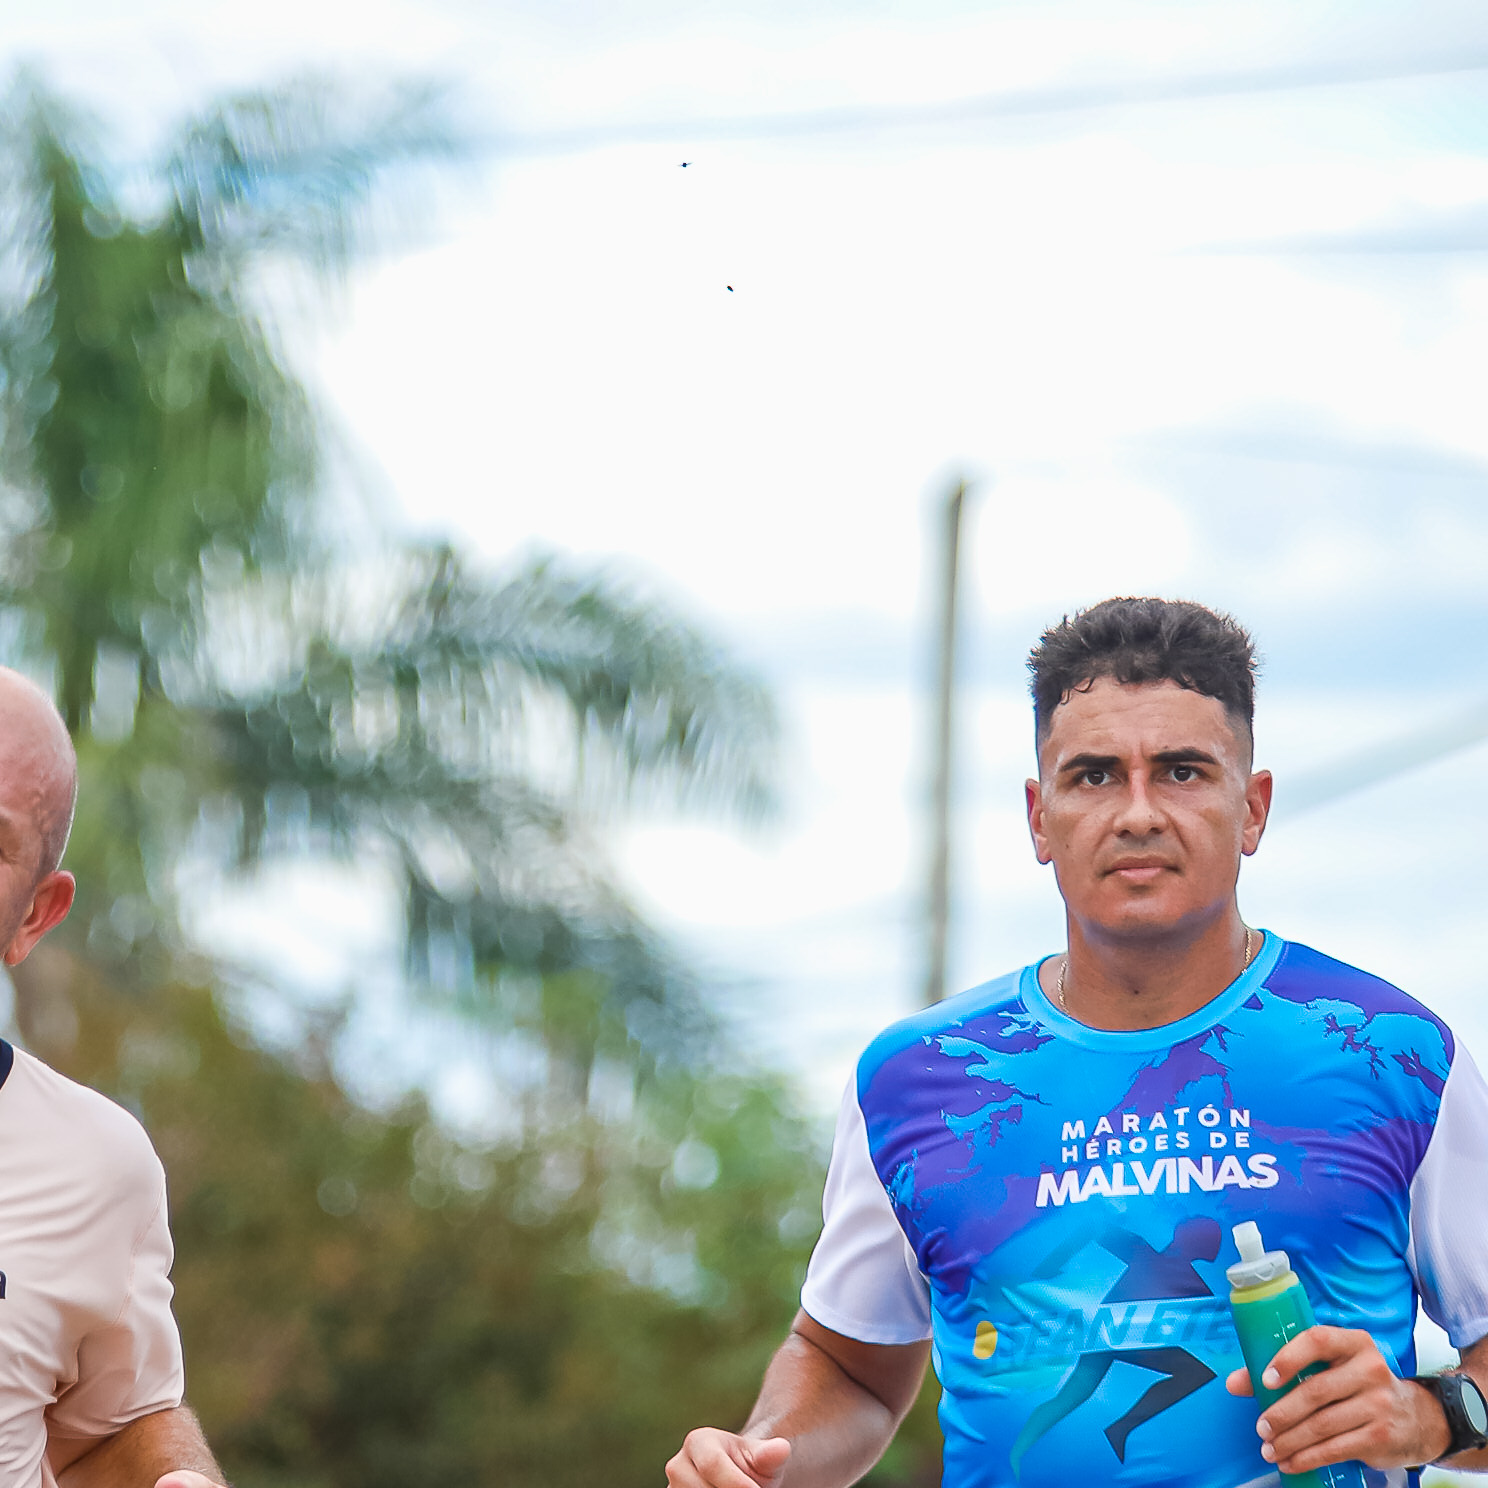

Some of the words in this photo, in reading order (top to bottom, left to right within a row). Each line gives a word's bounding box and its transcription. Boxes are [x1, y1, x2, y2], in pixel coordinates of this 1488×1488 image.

[1062, 1104, 1250, 1141] MARATÓN
[1062, 1131, 1190, 1163] HÉROES
[1210, 1132, 1250, 1149] DE
[1035, 1153, 1280, 1207] MALVINAS
